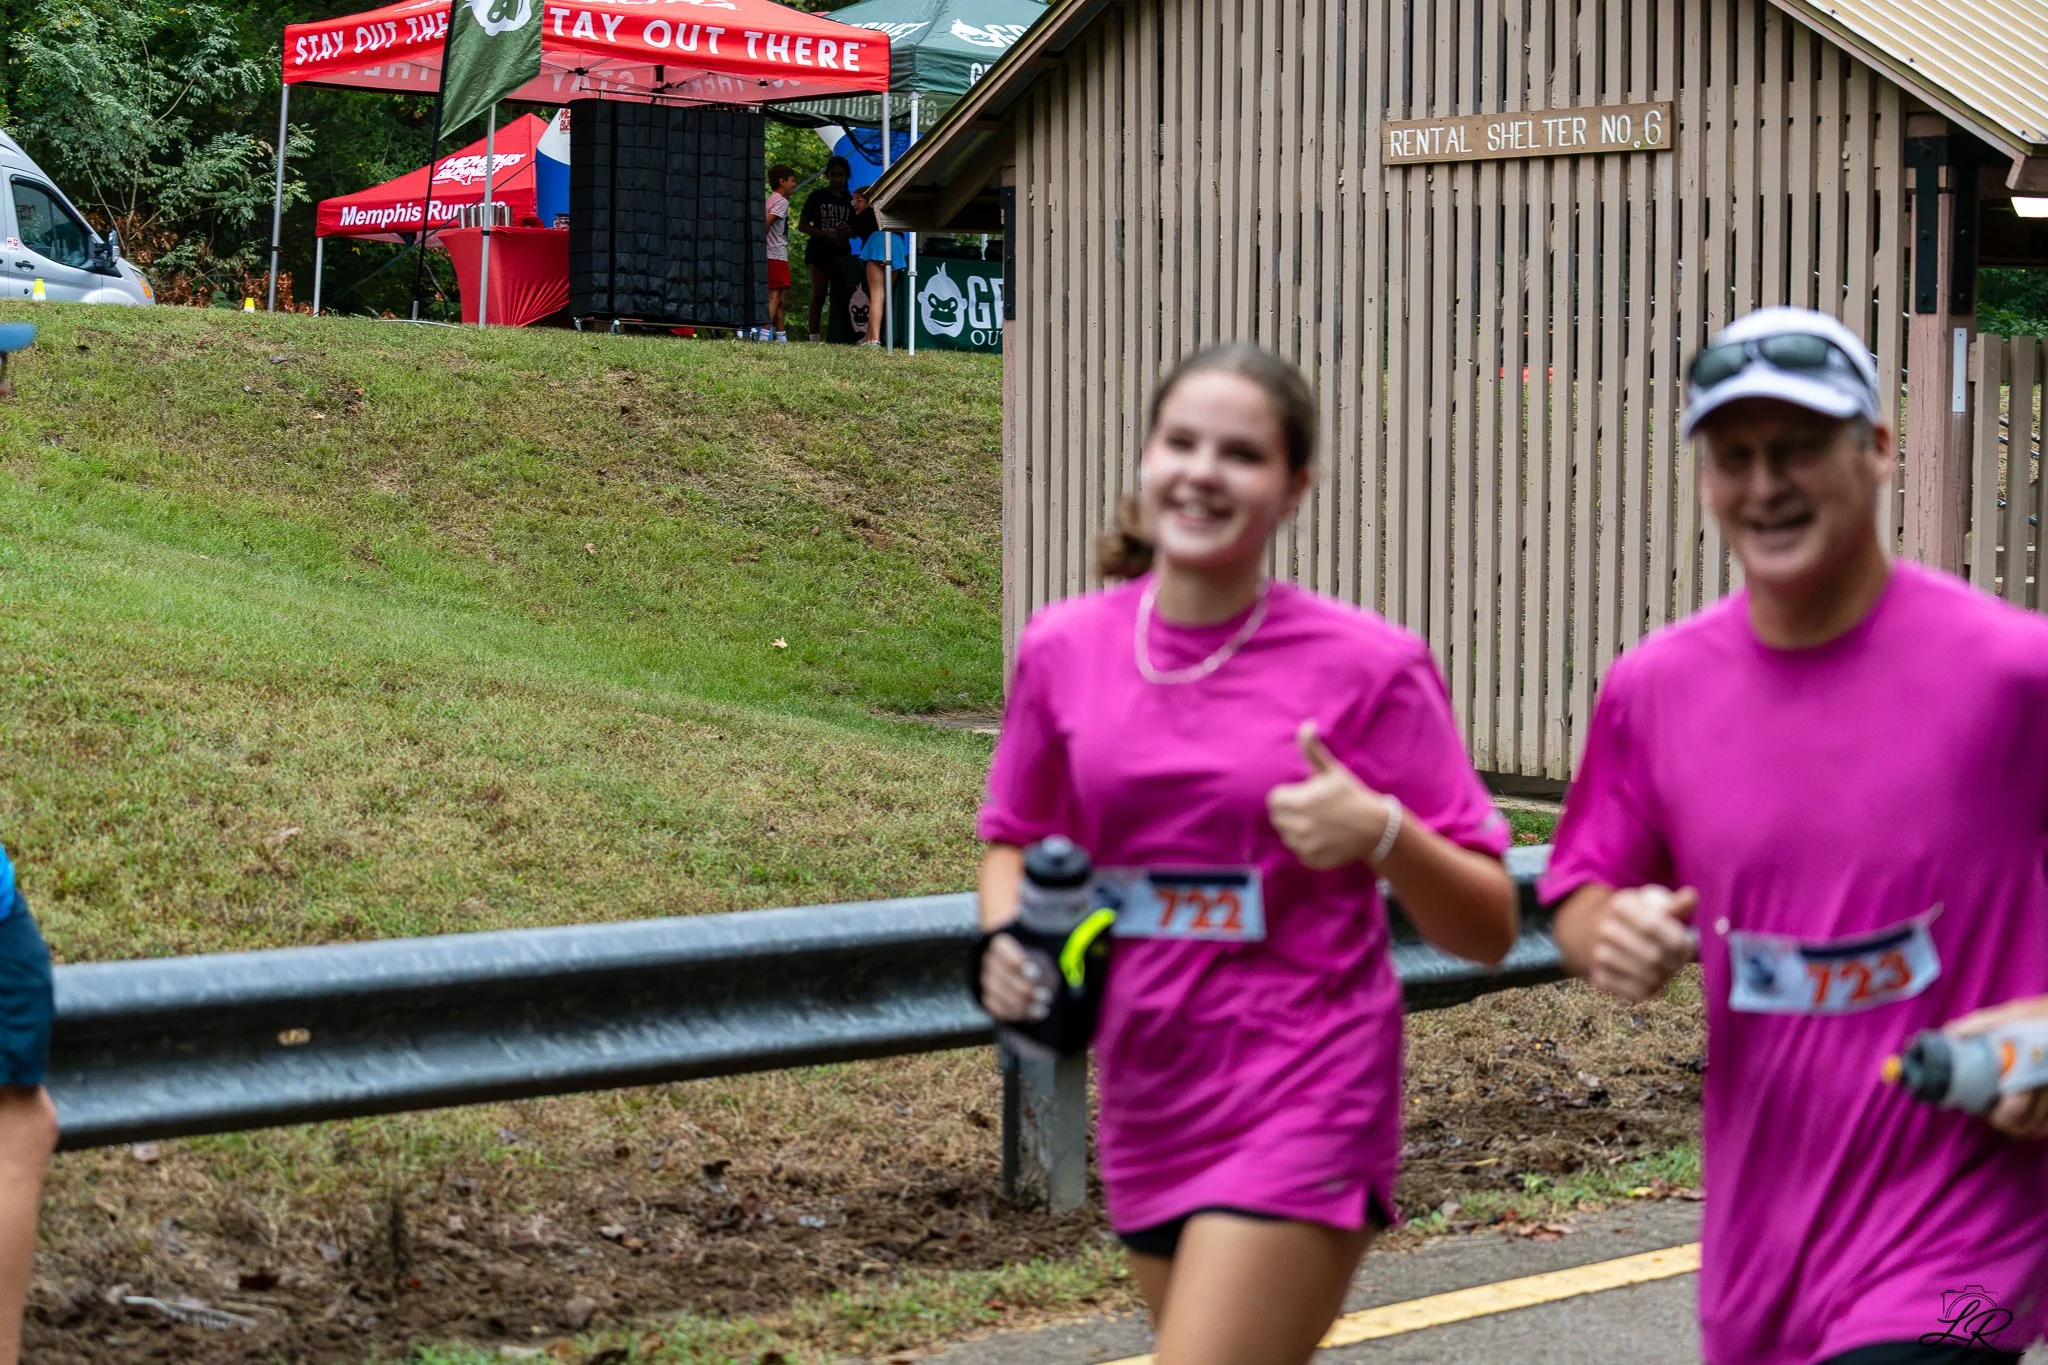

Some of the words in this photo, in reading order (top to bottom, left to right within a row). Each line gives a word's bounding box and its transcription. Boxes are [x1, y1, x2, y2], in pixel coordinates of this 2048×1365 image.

[295, 31, 344, 65] STAY
[353, 22, 397, 54] OUT
[405, 11, 450, 44] THE
[549, 7, 625, 43] TAY
[643, 19, 726, 55] OUT
[743, 30, 861, 72] THERE
[1390, 125, 1472, 157] RENTAL
[1487, 116, 1587, 151] SHELTER
[340, 201, 423, 228] Memphis
[1156, 888, 1243, 930] 722
[1806, 951, 1912, 1006] 723
